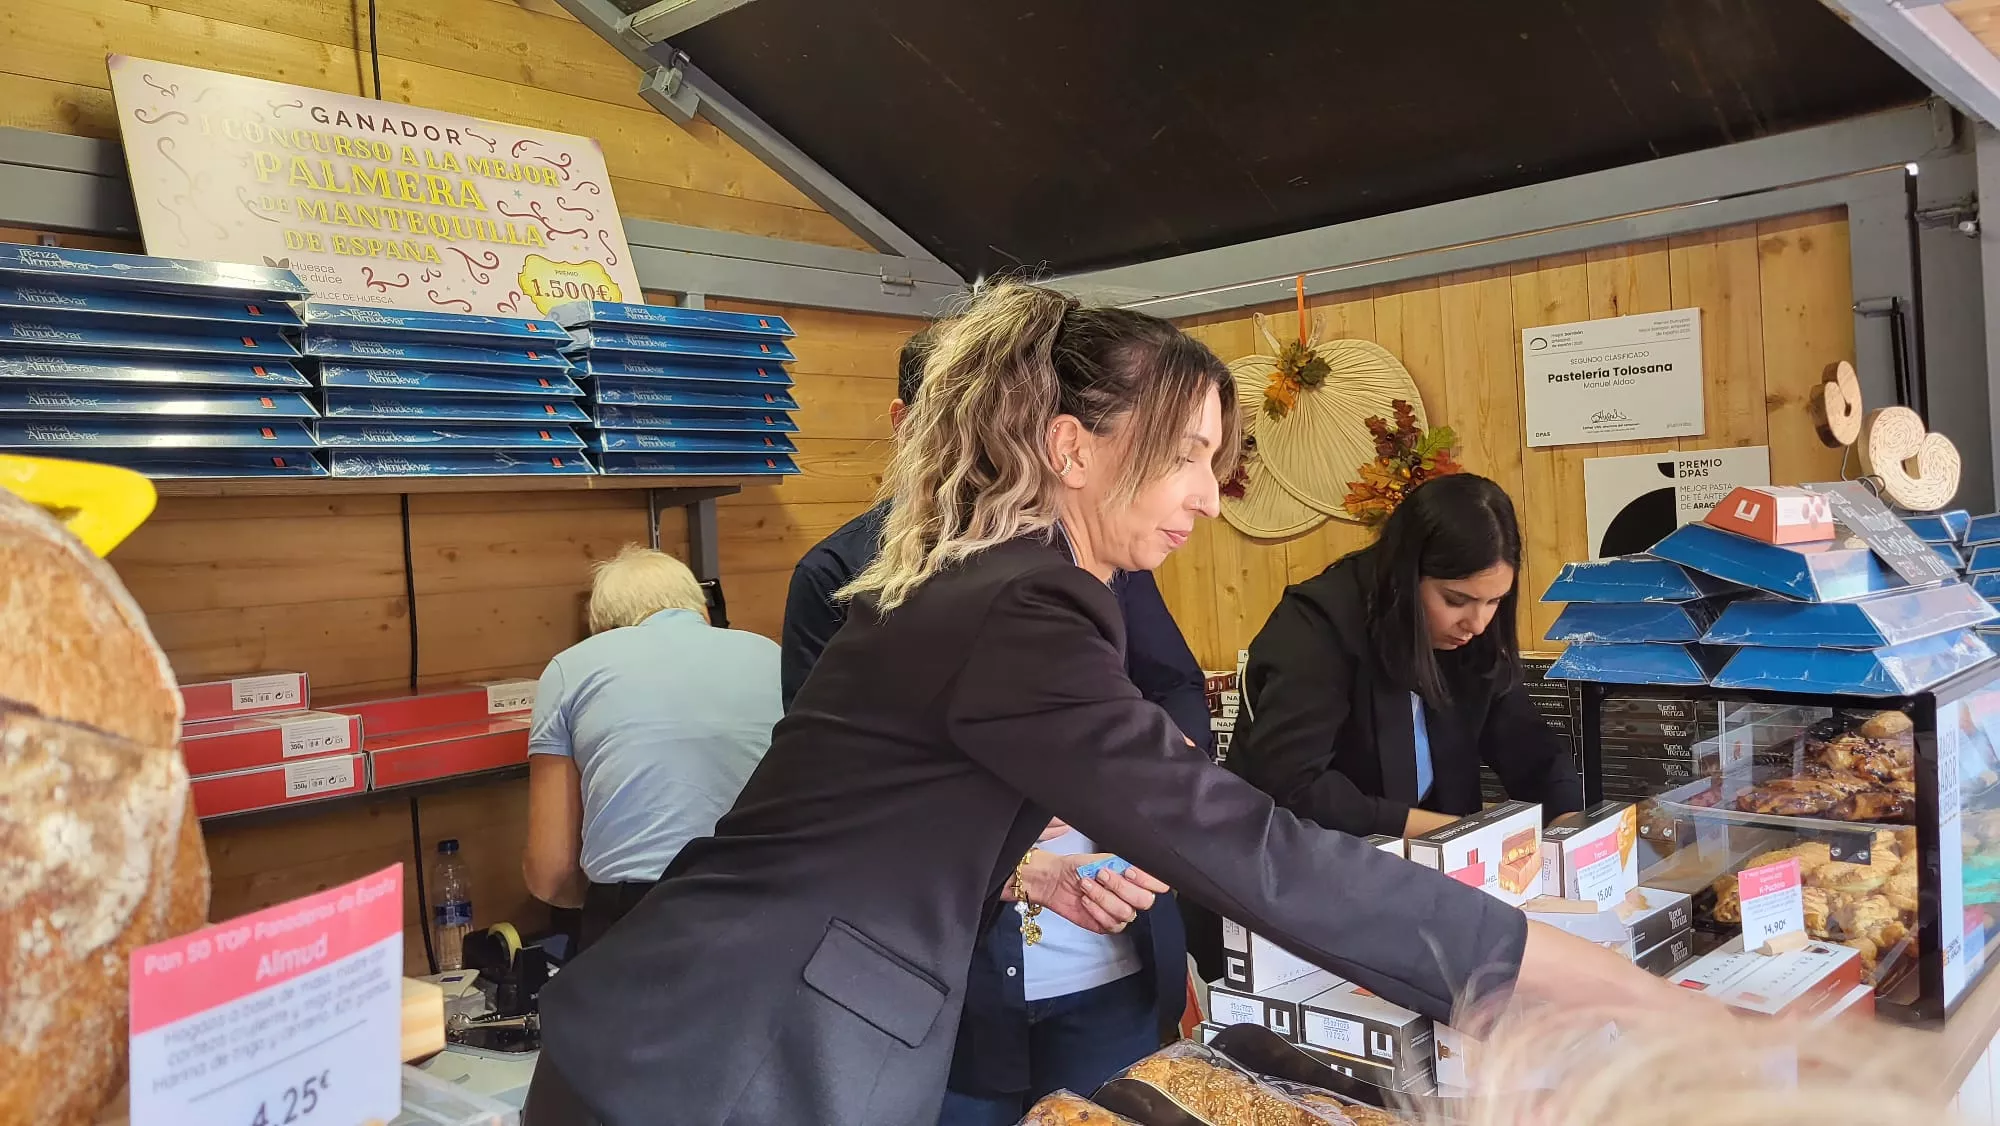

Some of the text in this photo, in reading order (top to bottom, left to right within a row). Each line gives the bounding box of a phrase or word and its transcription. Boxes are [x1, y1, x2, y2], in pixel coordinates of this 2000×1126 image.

[310, 106, 462, 145] GANADOR
[221, 118, 392, 162] CONCURSO
[401, 144, 420, 168] A
[424, 150, 462, 174] LA
[465, 155, 561, 188] MEJOR
[251, 150, 488, 212] PALMERA
[258, 193, 548, 248] DE MANTEQUILLA
[284, 229, 442, 264] DE ESPAÑA
[291, 261, 335, 273] Huesca
[311, 272, 343, 284] dulce
[531, 278, 613, 302] 1.500€
[1570, 350, 1649, 365] SEGUNDO CLASIFICADO
[1548, 362, 1673, 383] Pastelería Tolosana
[1583, 378, 1635, 389] Manuel Aldao
[1679, 458, 1722, 469] PREMIO
[1679, 468, 1709, 478] DPAS
[1680, 483, 1733, 493] MEJOR PASTA
[1704, 492, 1728, 500] ARTES
[144, 952, 182, 976] Pan
[187, 939, 212, 963] 50
[216, 927, 251, 953] TOP
[256, 933, 328, 982] Almud
